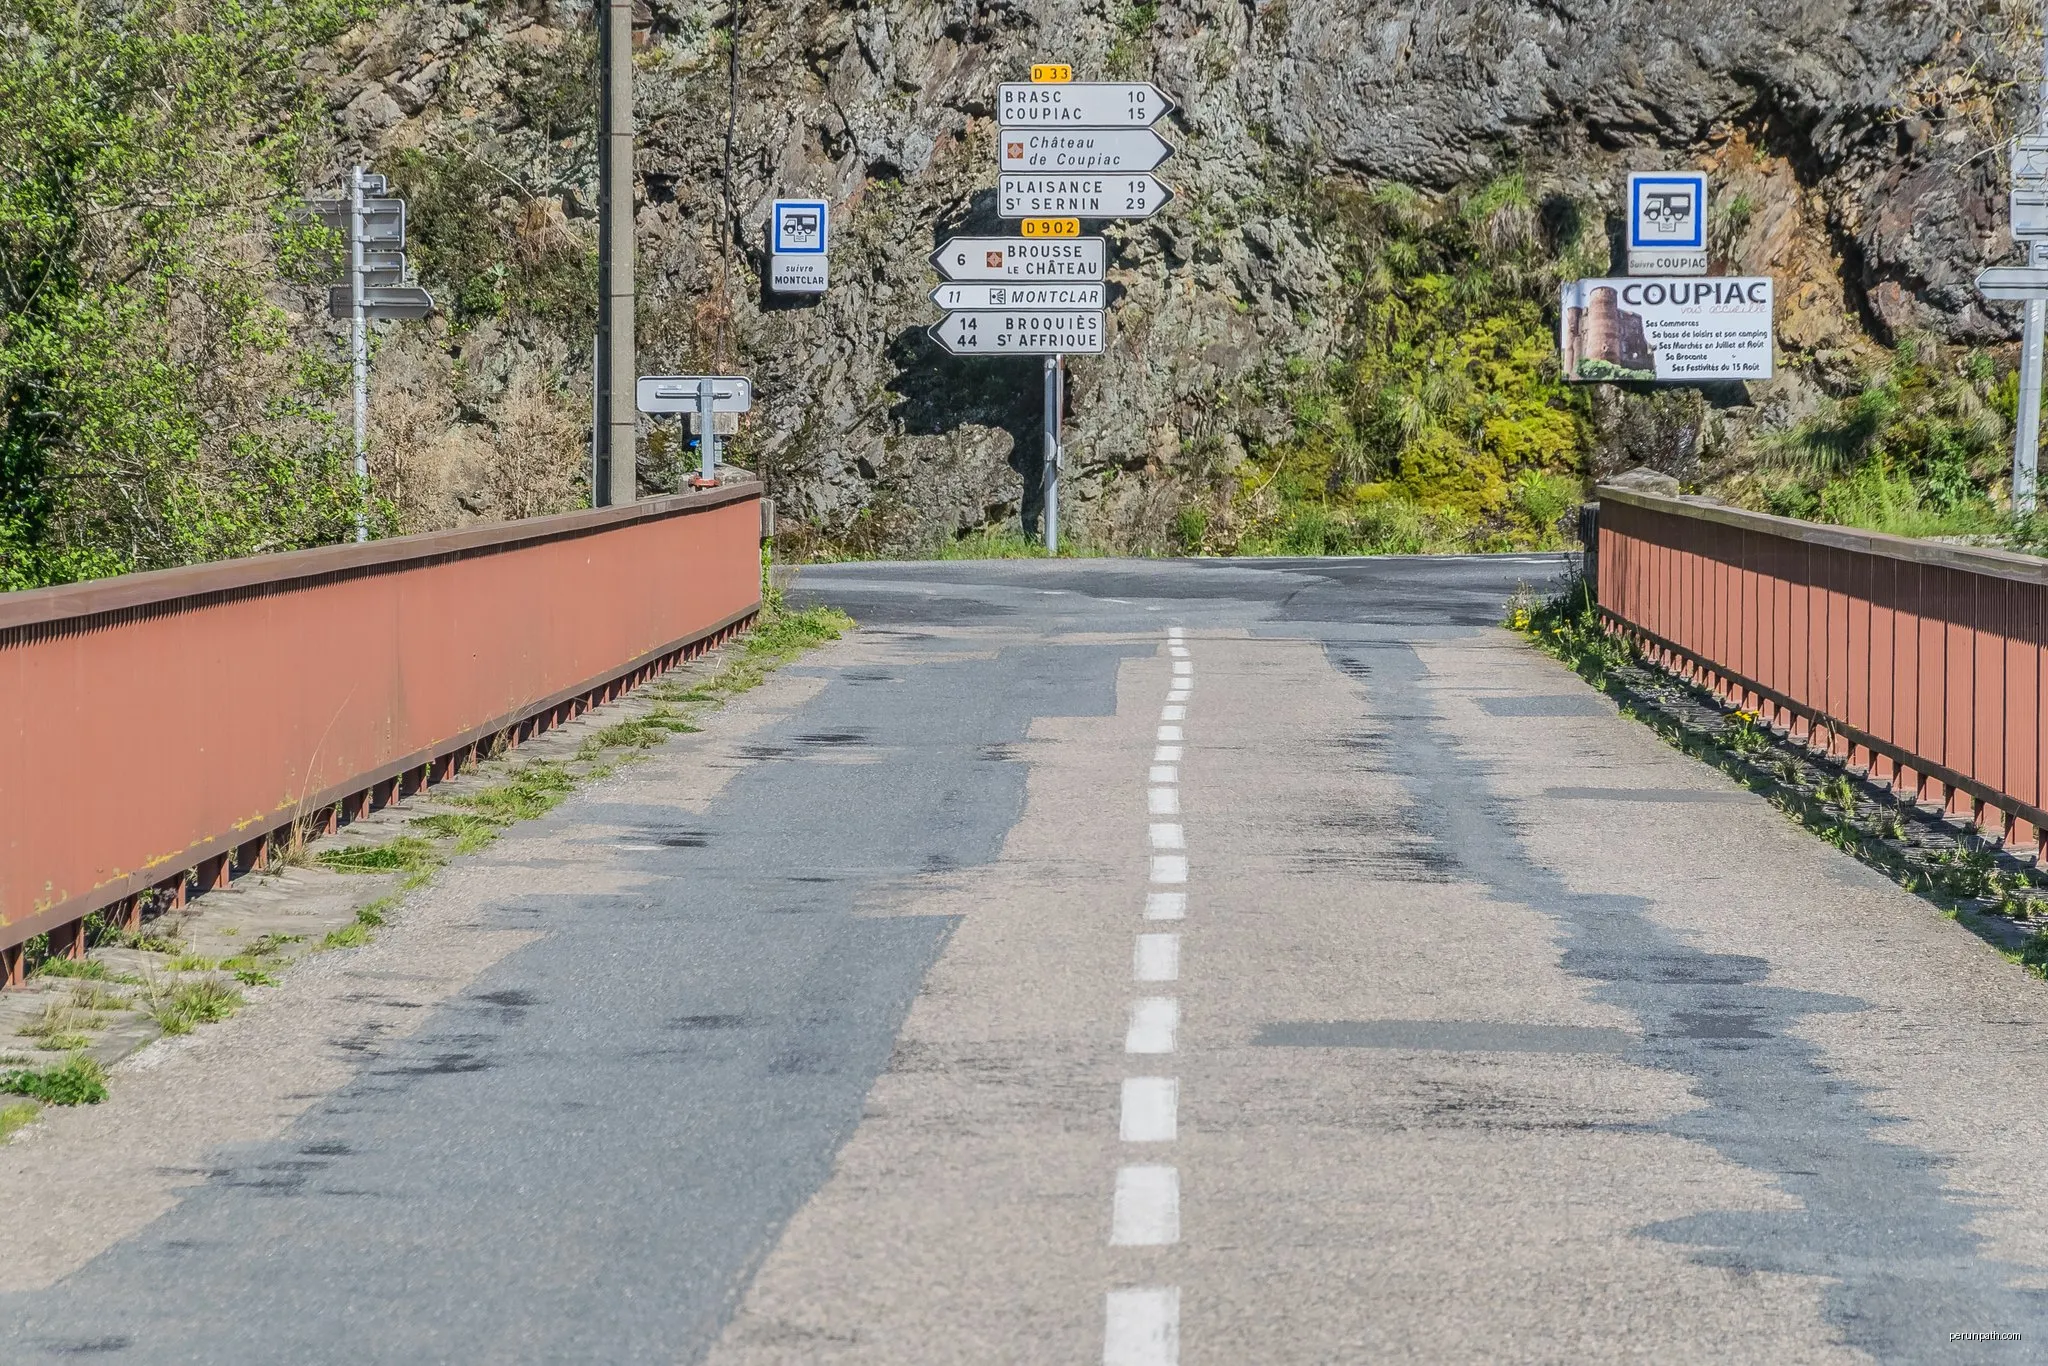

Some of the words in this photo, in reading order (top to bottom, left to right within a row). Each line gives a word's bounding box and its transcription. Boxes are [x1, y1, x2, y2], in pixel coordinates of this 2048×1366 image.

[1034, 69, 1043, 80] D
[1050, 68, 1069, 80] 33
[1005, 91, 1062, 104] BRASC
[1128, 91, 1146, 104] 10
[1005, 108, 1083, 121] COUPIAC
[1128, 108, 1146, 121] 15
[1029, 136, 1094, 150] Château
[1029, 153, 1046, 166] de
[1056, 153, 1121, 169] Coupiac
[1005, 181, 1103, 194] PLAISANCE
[1128, 181, 1146, 194] 19
[1031, 198, 1100, 211] SERNIN
[1126, 198, 1146, 211] 29
[1026, 221, 1036, 234] D
[1042, 221, 1076, 234] 902
[1007, 245, 1083, 259] BROUSSE
[957, 253, 967, 267] 6
[1629, 259, 1655, 269] Suivre
[1656, 257, 1706, 269] COUPIAC
[785, 264, 814, 273] suivre
[1007, 266, 1020, 275] LE
[1026, 259, 1098, 275] CHÂTEAU
[774, 275, 825, 285] MONTCLAR
[948, 291, 961, 304] 11
[1011, 290, 1099, 304] MONTCLAR
[1622, 282, 1767, 306] COUPIAC
[959, 317, 978, 331] 14
[1005, 315, 1098, 330] BROQUIÈS
[1645, 320, 1658, 328] Ses
[1659, 319, 1700, 328] Commerces
[957, 334, 978, 347] 44
[1019, 334, 1098, 347] AFFRIQUE
[1663, 330, 1680, 338] base
[1681, 330, 1692, 338] de
[1693, 330, 1714, 338] loisirs
[1739, 329, 1768, 339] camping
[1738, 341, 1746, 349] et
[1677, 353, 1708, 361] Brocante
[1672, 364, 1685, 372] Ses
[1686, 362, 1719, 372] Festivités
[1721, 363, 1730, 371] du
[1733, 362, 1741, 371] 15
